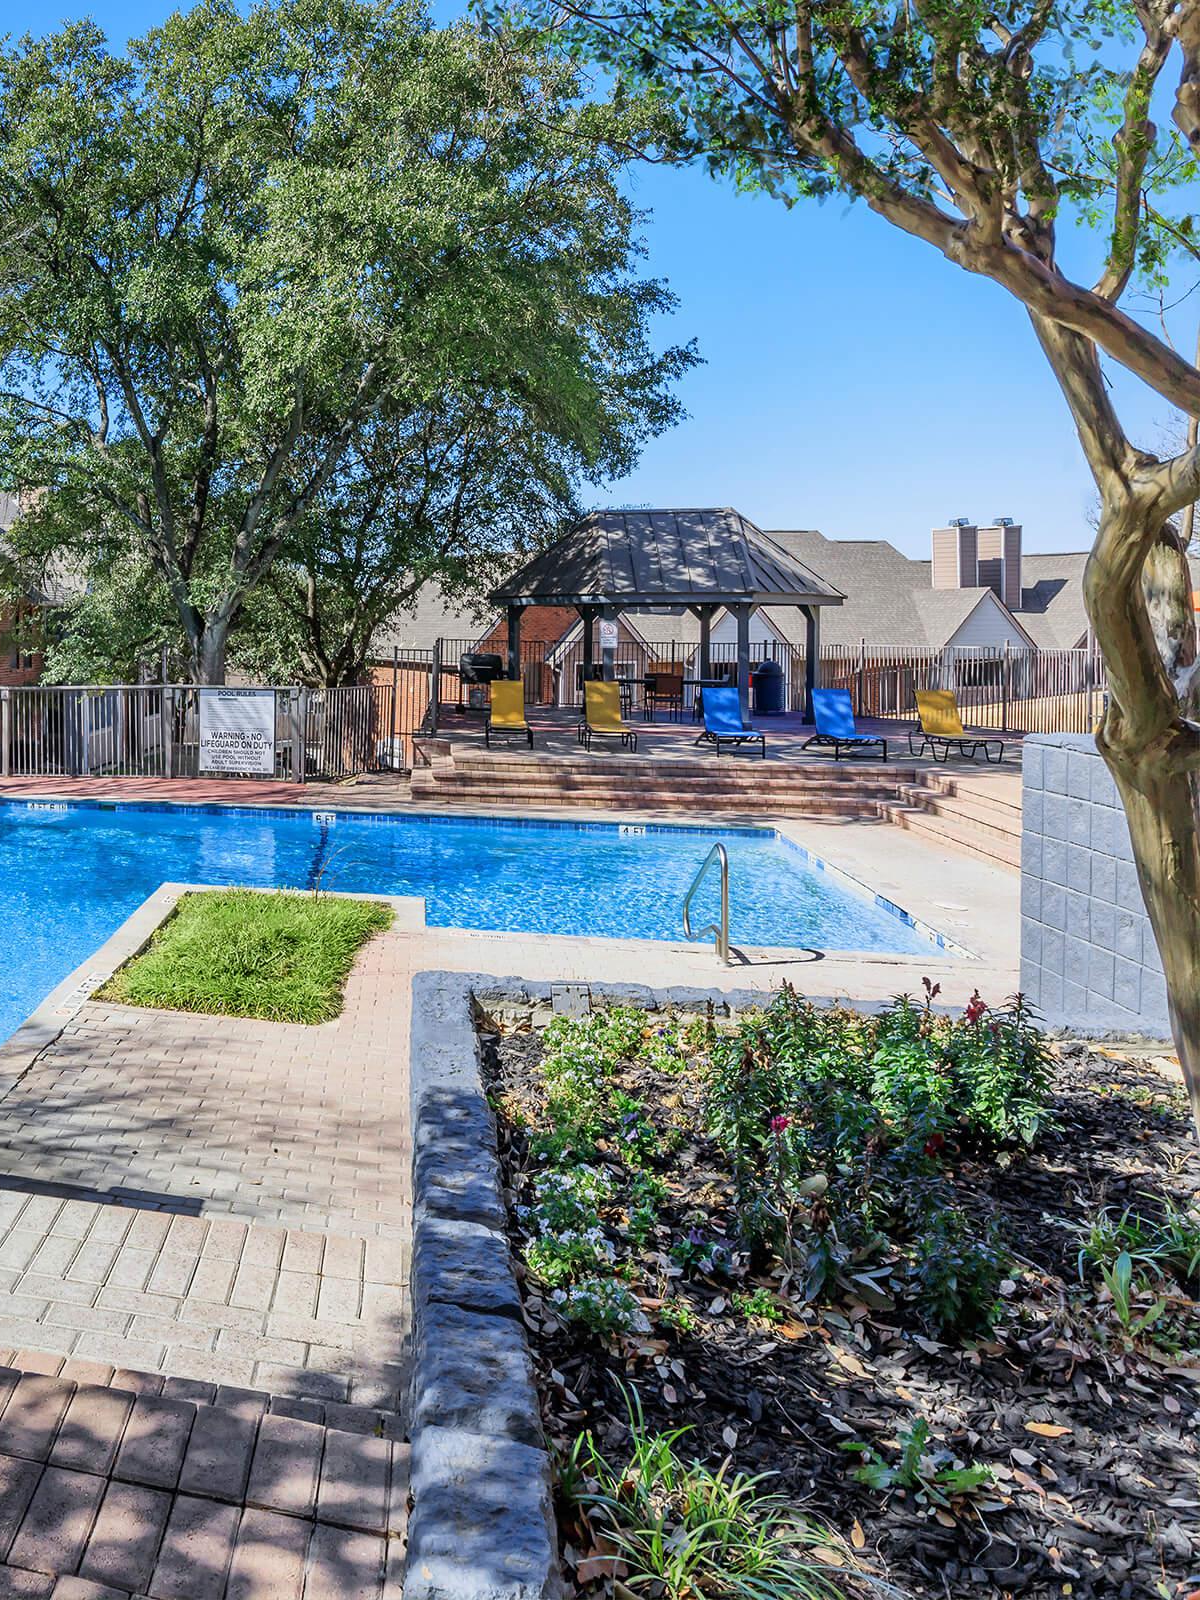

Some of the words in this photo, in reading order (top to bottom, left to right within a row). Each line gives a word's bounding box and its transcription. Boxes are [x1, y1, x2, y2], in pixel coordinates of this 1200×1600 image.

[211, 731, 245, 740] WARNING
[251, 732, 262, 741] NO
[201, 739, 240, 749] LIFEGUARD
[241, 740, 252, 749] ON
[253, 741, 273, 750] DUTY
